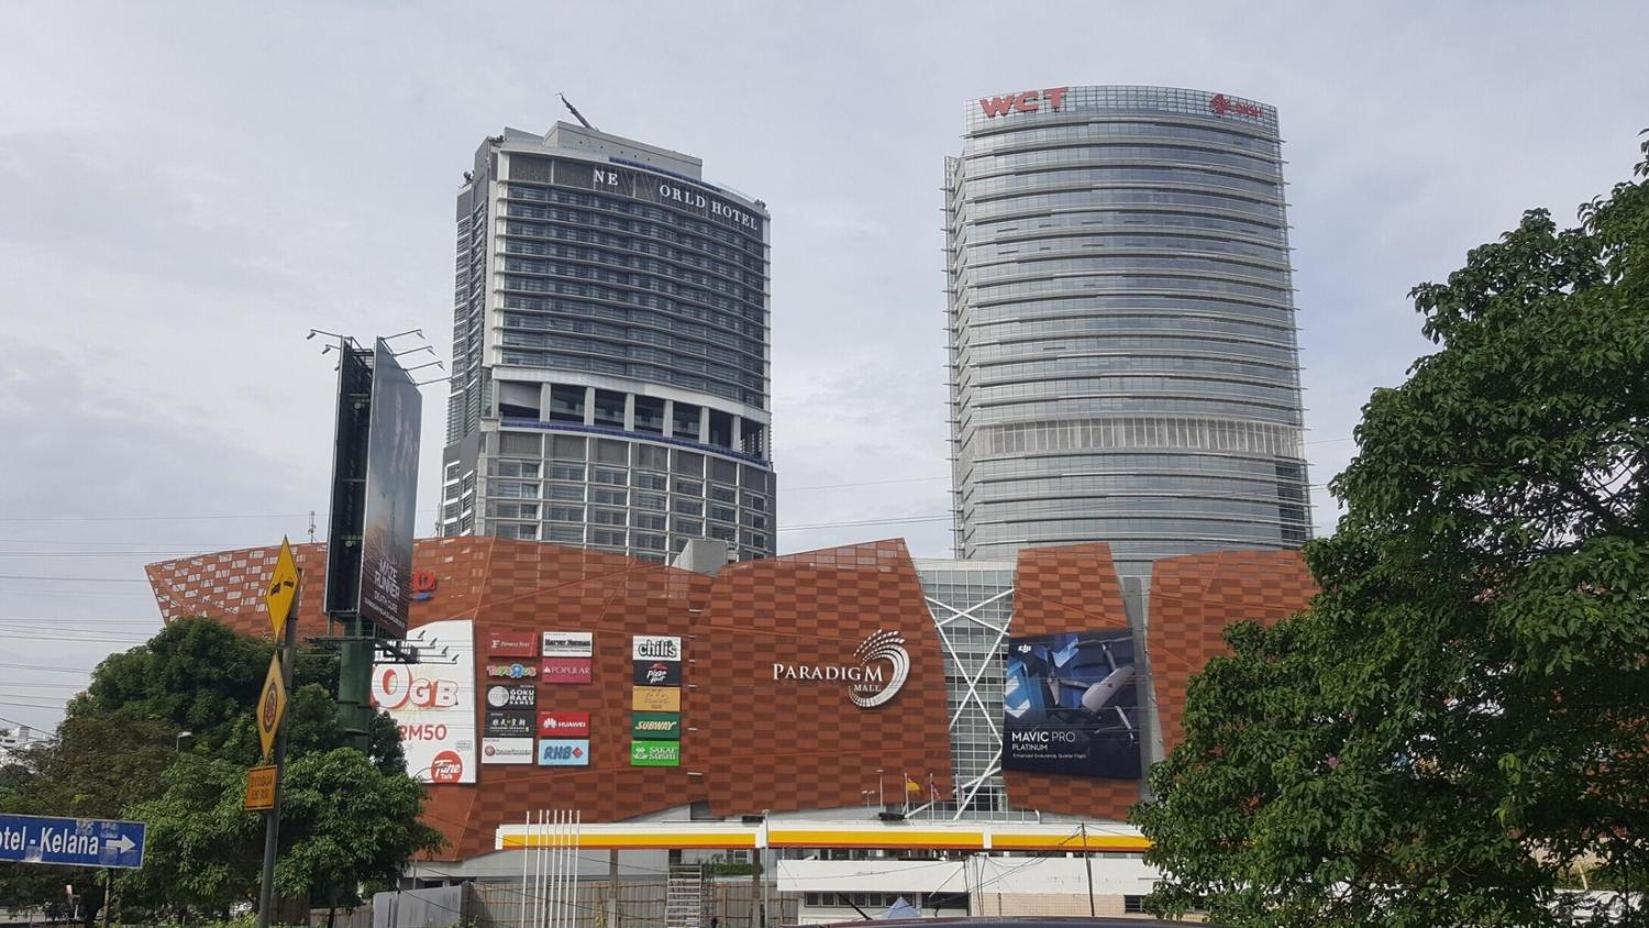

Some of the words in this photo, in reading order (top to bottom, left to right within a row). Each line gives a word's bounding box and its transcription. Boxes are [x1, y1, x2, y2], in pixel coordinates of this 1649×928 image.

[980, 87, 1068, 119] WCT
[710, 200, 758, 231] HOTEL
[551, 666, 591, 674] POPULAR
[773, 663, 883, 682] PARADIGM
[853, 683, 882, 692] MALL
[635, 720, 677, 731] SUBWAY
[1011, 731, 1049, 742] MAVIC
[1051, 731, 1076, 743] PRO
[543, 745, 572, 760] RHB
[1011, 743, 1048, 751] PLATINUM
[41, 827, 99, 856] Kelana
